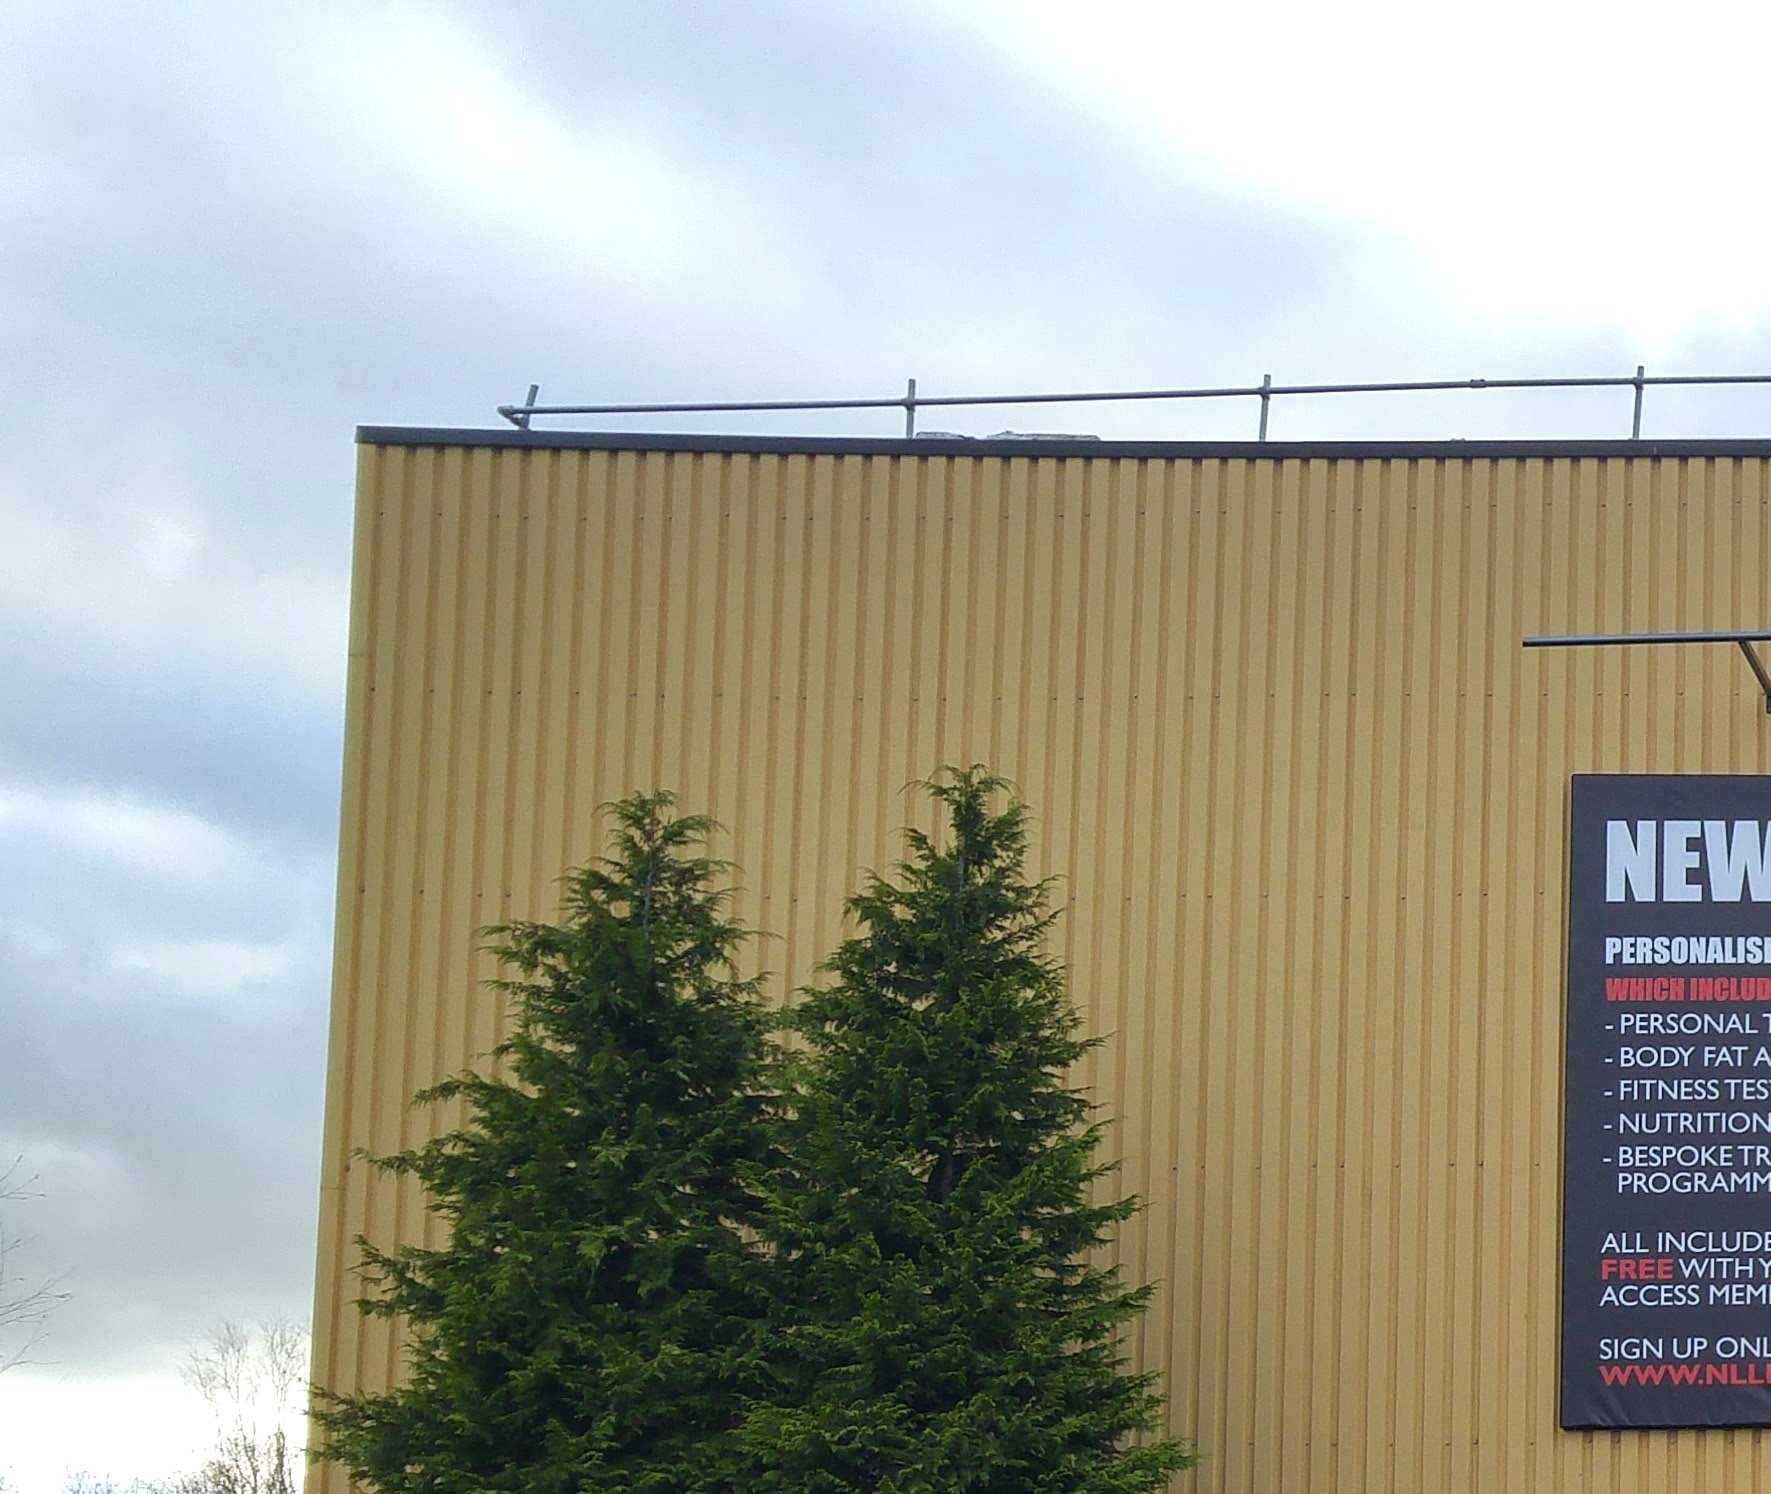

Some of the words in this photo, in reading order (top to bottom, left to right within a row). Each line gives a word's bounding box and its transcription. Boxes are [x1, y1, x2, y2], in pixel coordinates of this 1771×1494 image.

[1605, 978, 1685, 1002] WHICH
[1621, 1013, 1758, 1036] PERSONAL
[1621, 1047, 1695, 1069] BODY
[1704, 1047, 1748, 1068] FAT
[1620, 1079, 1720, 1102] FITNESS
[1619, 1146, 1734, 1169] BESPOKE
[1601, 1233, 1650, 1255] ALL
[1602, 1259, 1674, 1281] FREE
[1680, 1258, 1756, 1280] WITH
[1600, 1285, 1701, 1308] ACCESS
[1600, 1339, 1666, 1361] SIGN
[1673, 1338, 1709, 1360] UP
